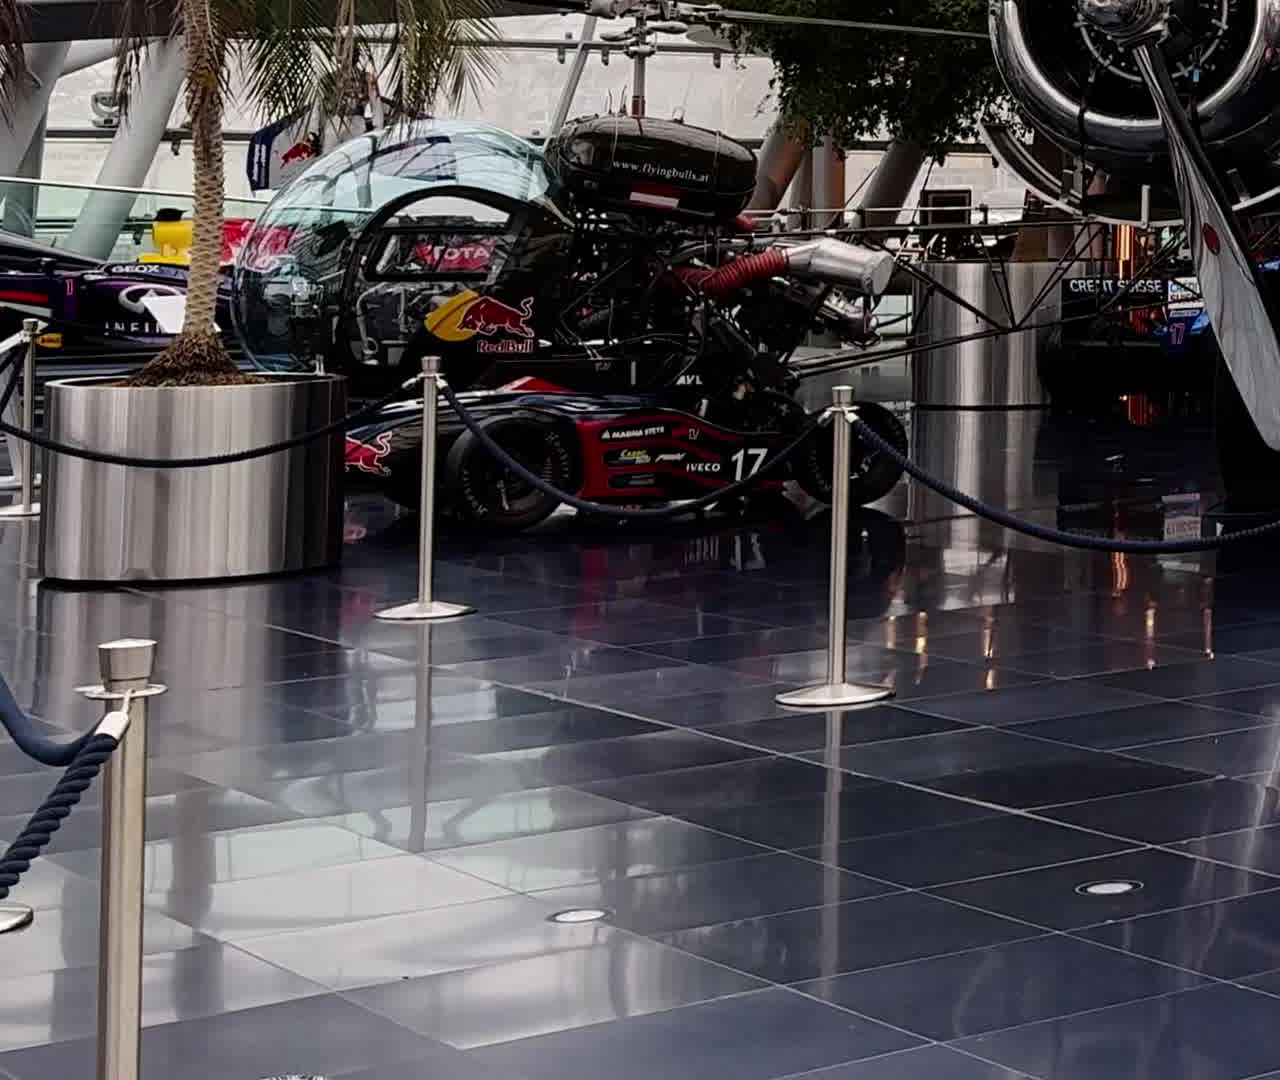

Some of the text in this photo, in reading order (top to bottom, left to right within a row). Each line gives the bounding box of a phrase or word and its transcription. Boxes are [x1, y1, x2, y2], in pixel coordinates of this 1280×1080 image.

[612, 160, 709, 183] www.flyingbulls.at
[433, 246, 491, 261] TOTA
[111, 264, 159, 274] GEOX
[1116, 278, 1164, 294] SISSE
[676, 374, 703, 385] AVL
[686, 463, 721, 472] IVECO
[731, 448, 768, 481] 17
